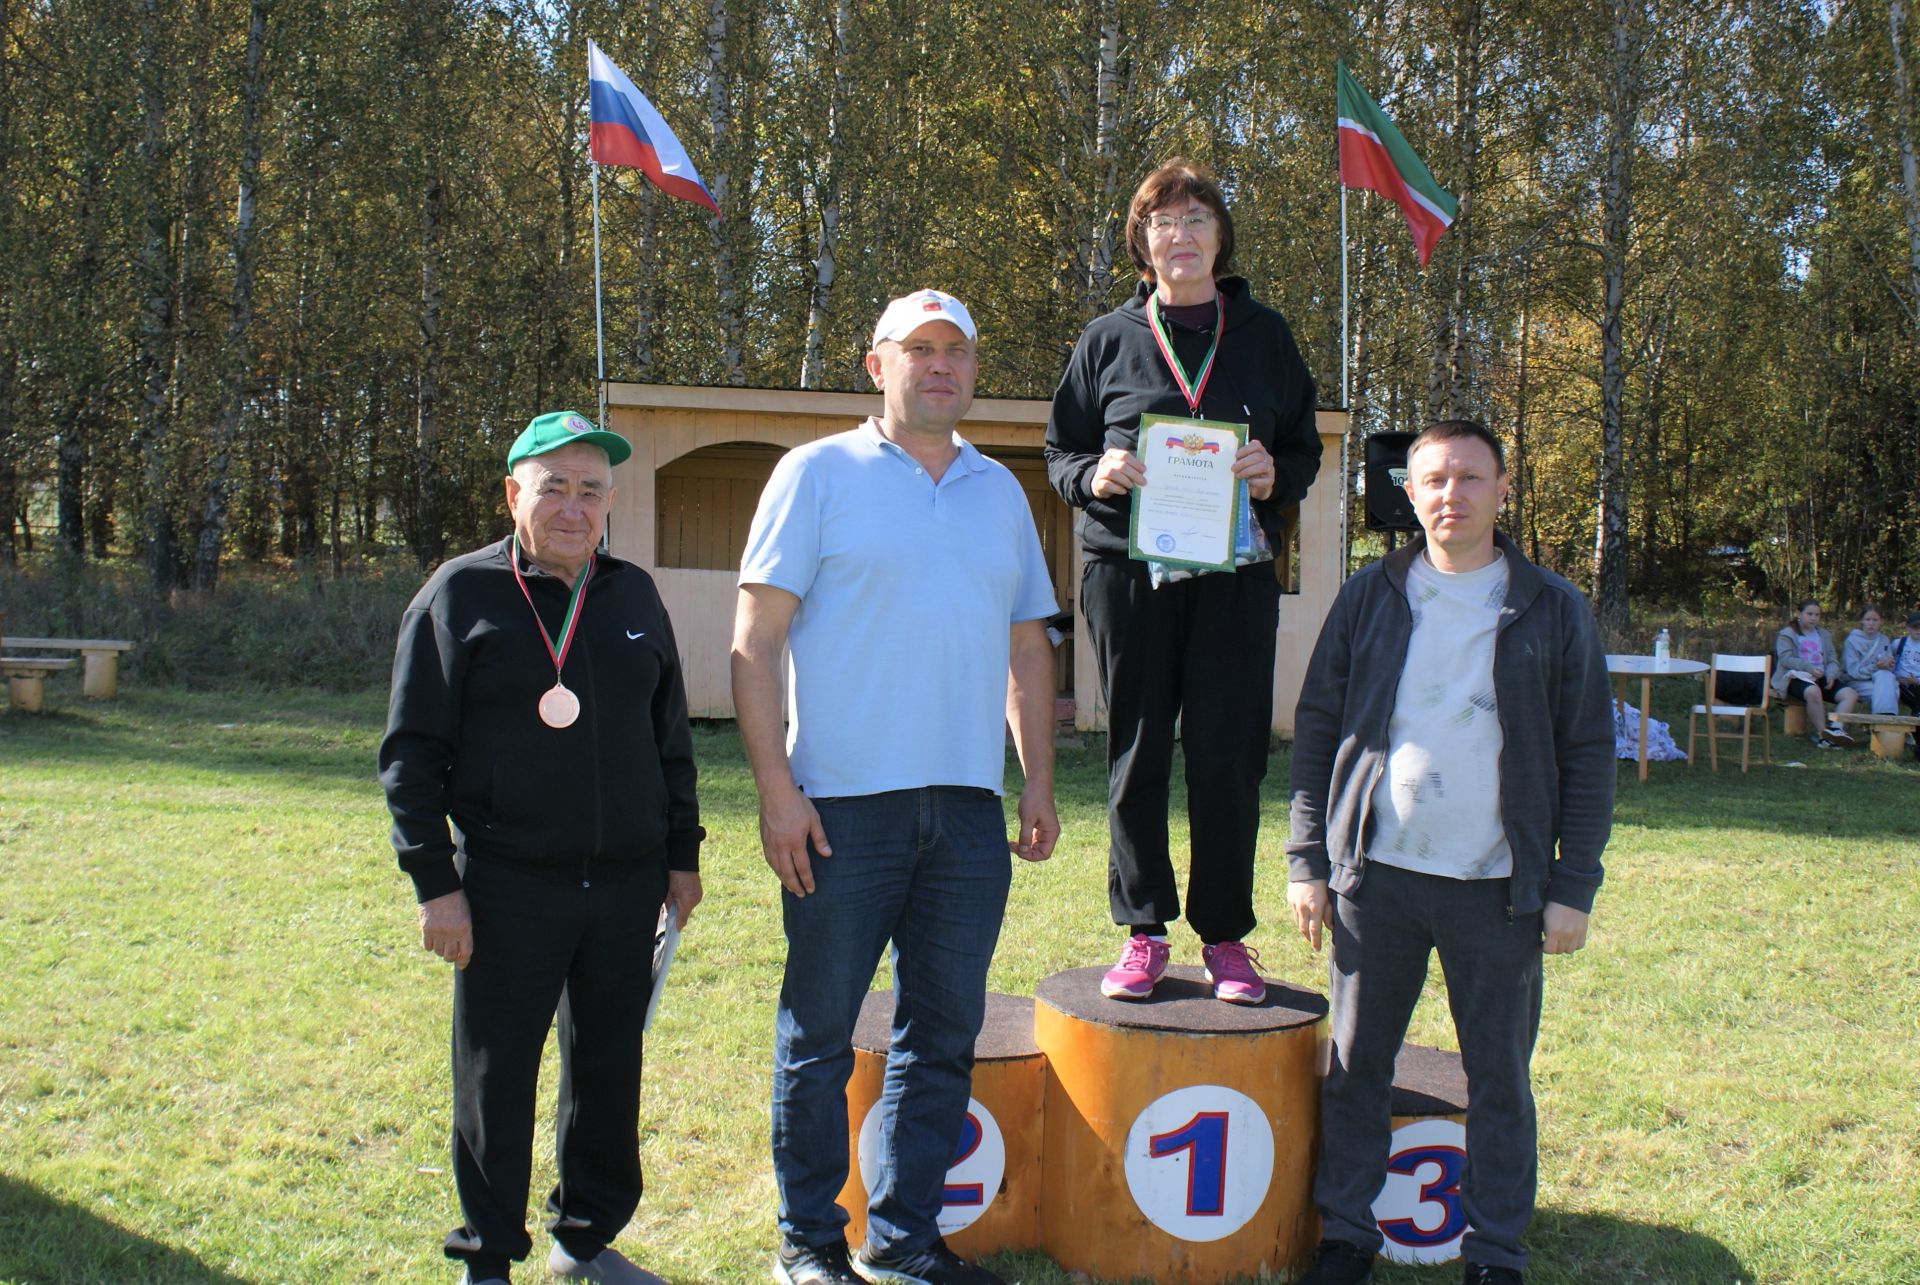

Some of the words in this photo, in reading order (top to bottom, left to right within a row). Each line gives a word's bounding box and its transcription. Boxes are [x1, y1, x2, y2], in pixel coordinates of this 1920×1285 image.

[1168, 456, 1214, 469] ГРАМОТА
[1150, 1112, 1229, 1216] 1
[1377, 1145, 1468, 1246] 3
